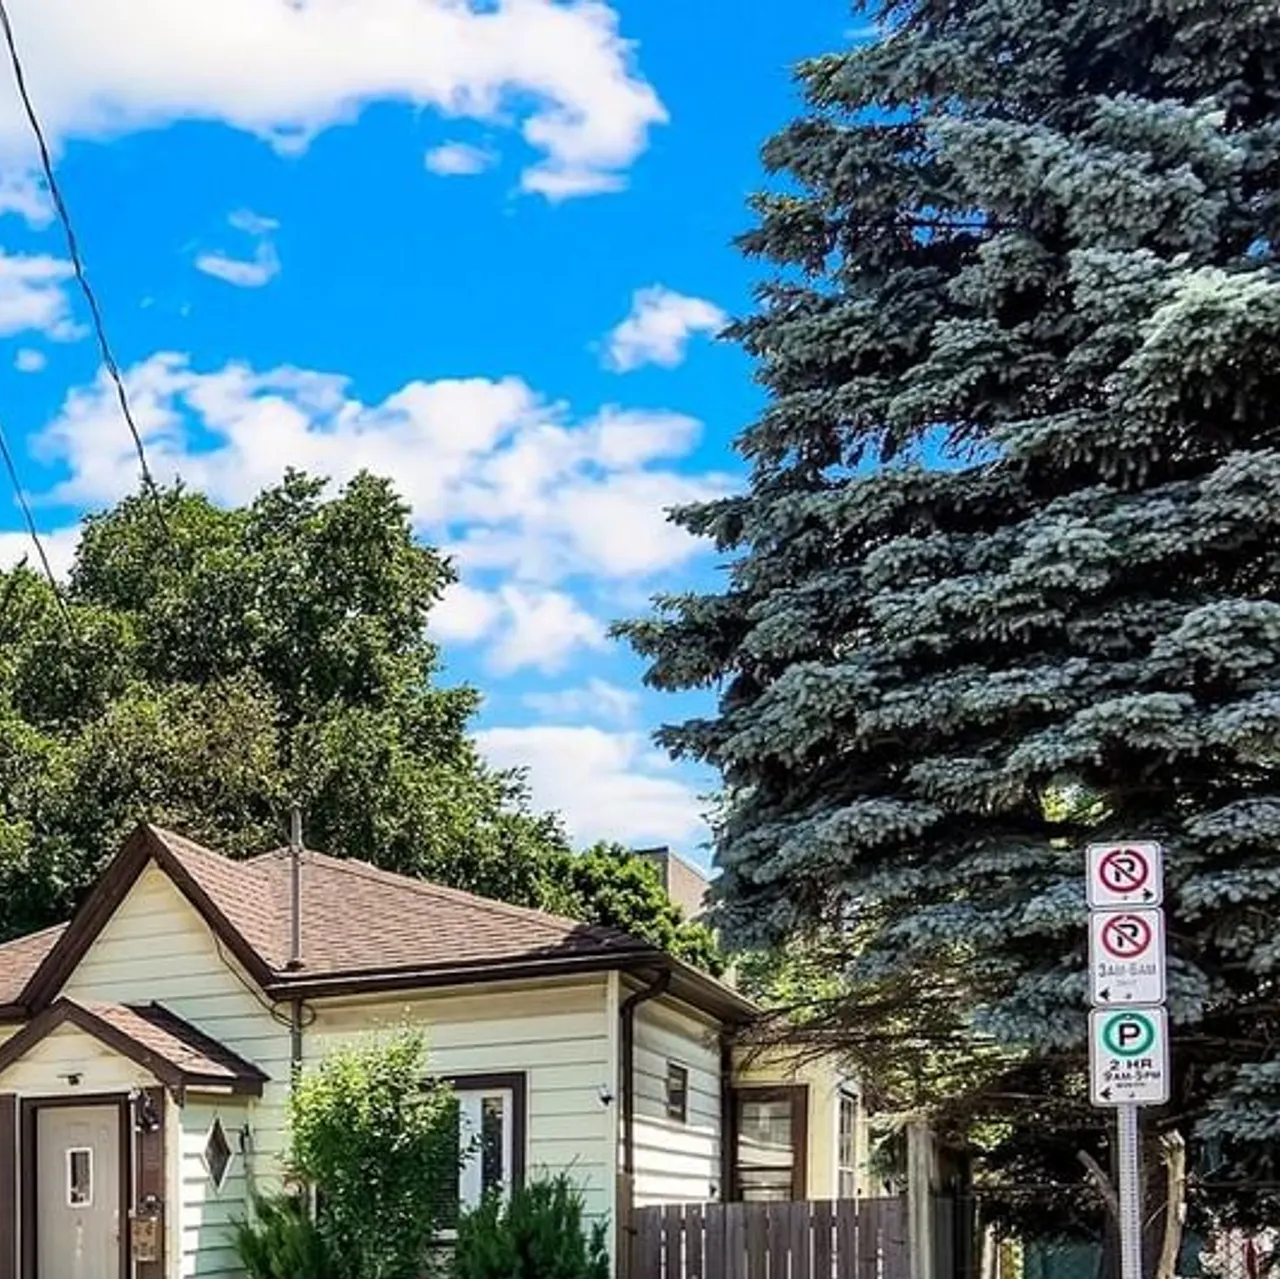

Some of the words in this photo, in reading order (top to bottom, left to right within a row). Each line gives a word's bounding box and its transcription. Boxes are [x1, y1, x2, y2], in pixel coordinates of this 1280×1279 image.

[1119, 1022, 1141, 1047] P
[1109, 1059, 1120, 1071] 2
[1126, 1058, 1152, 1069] HR
